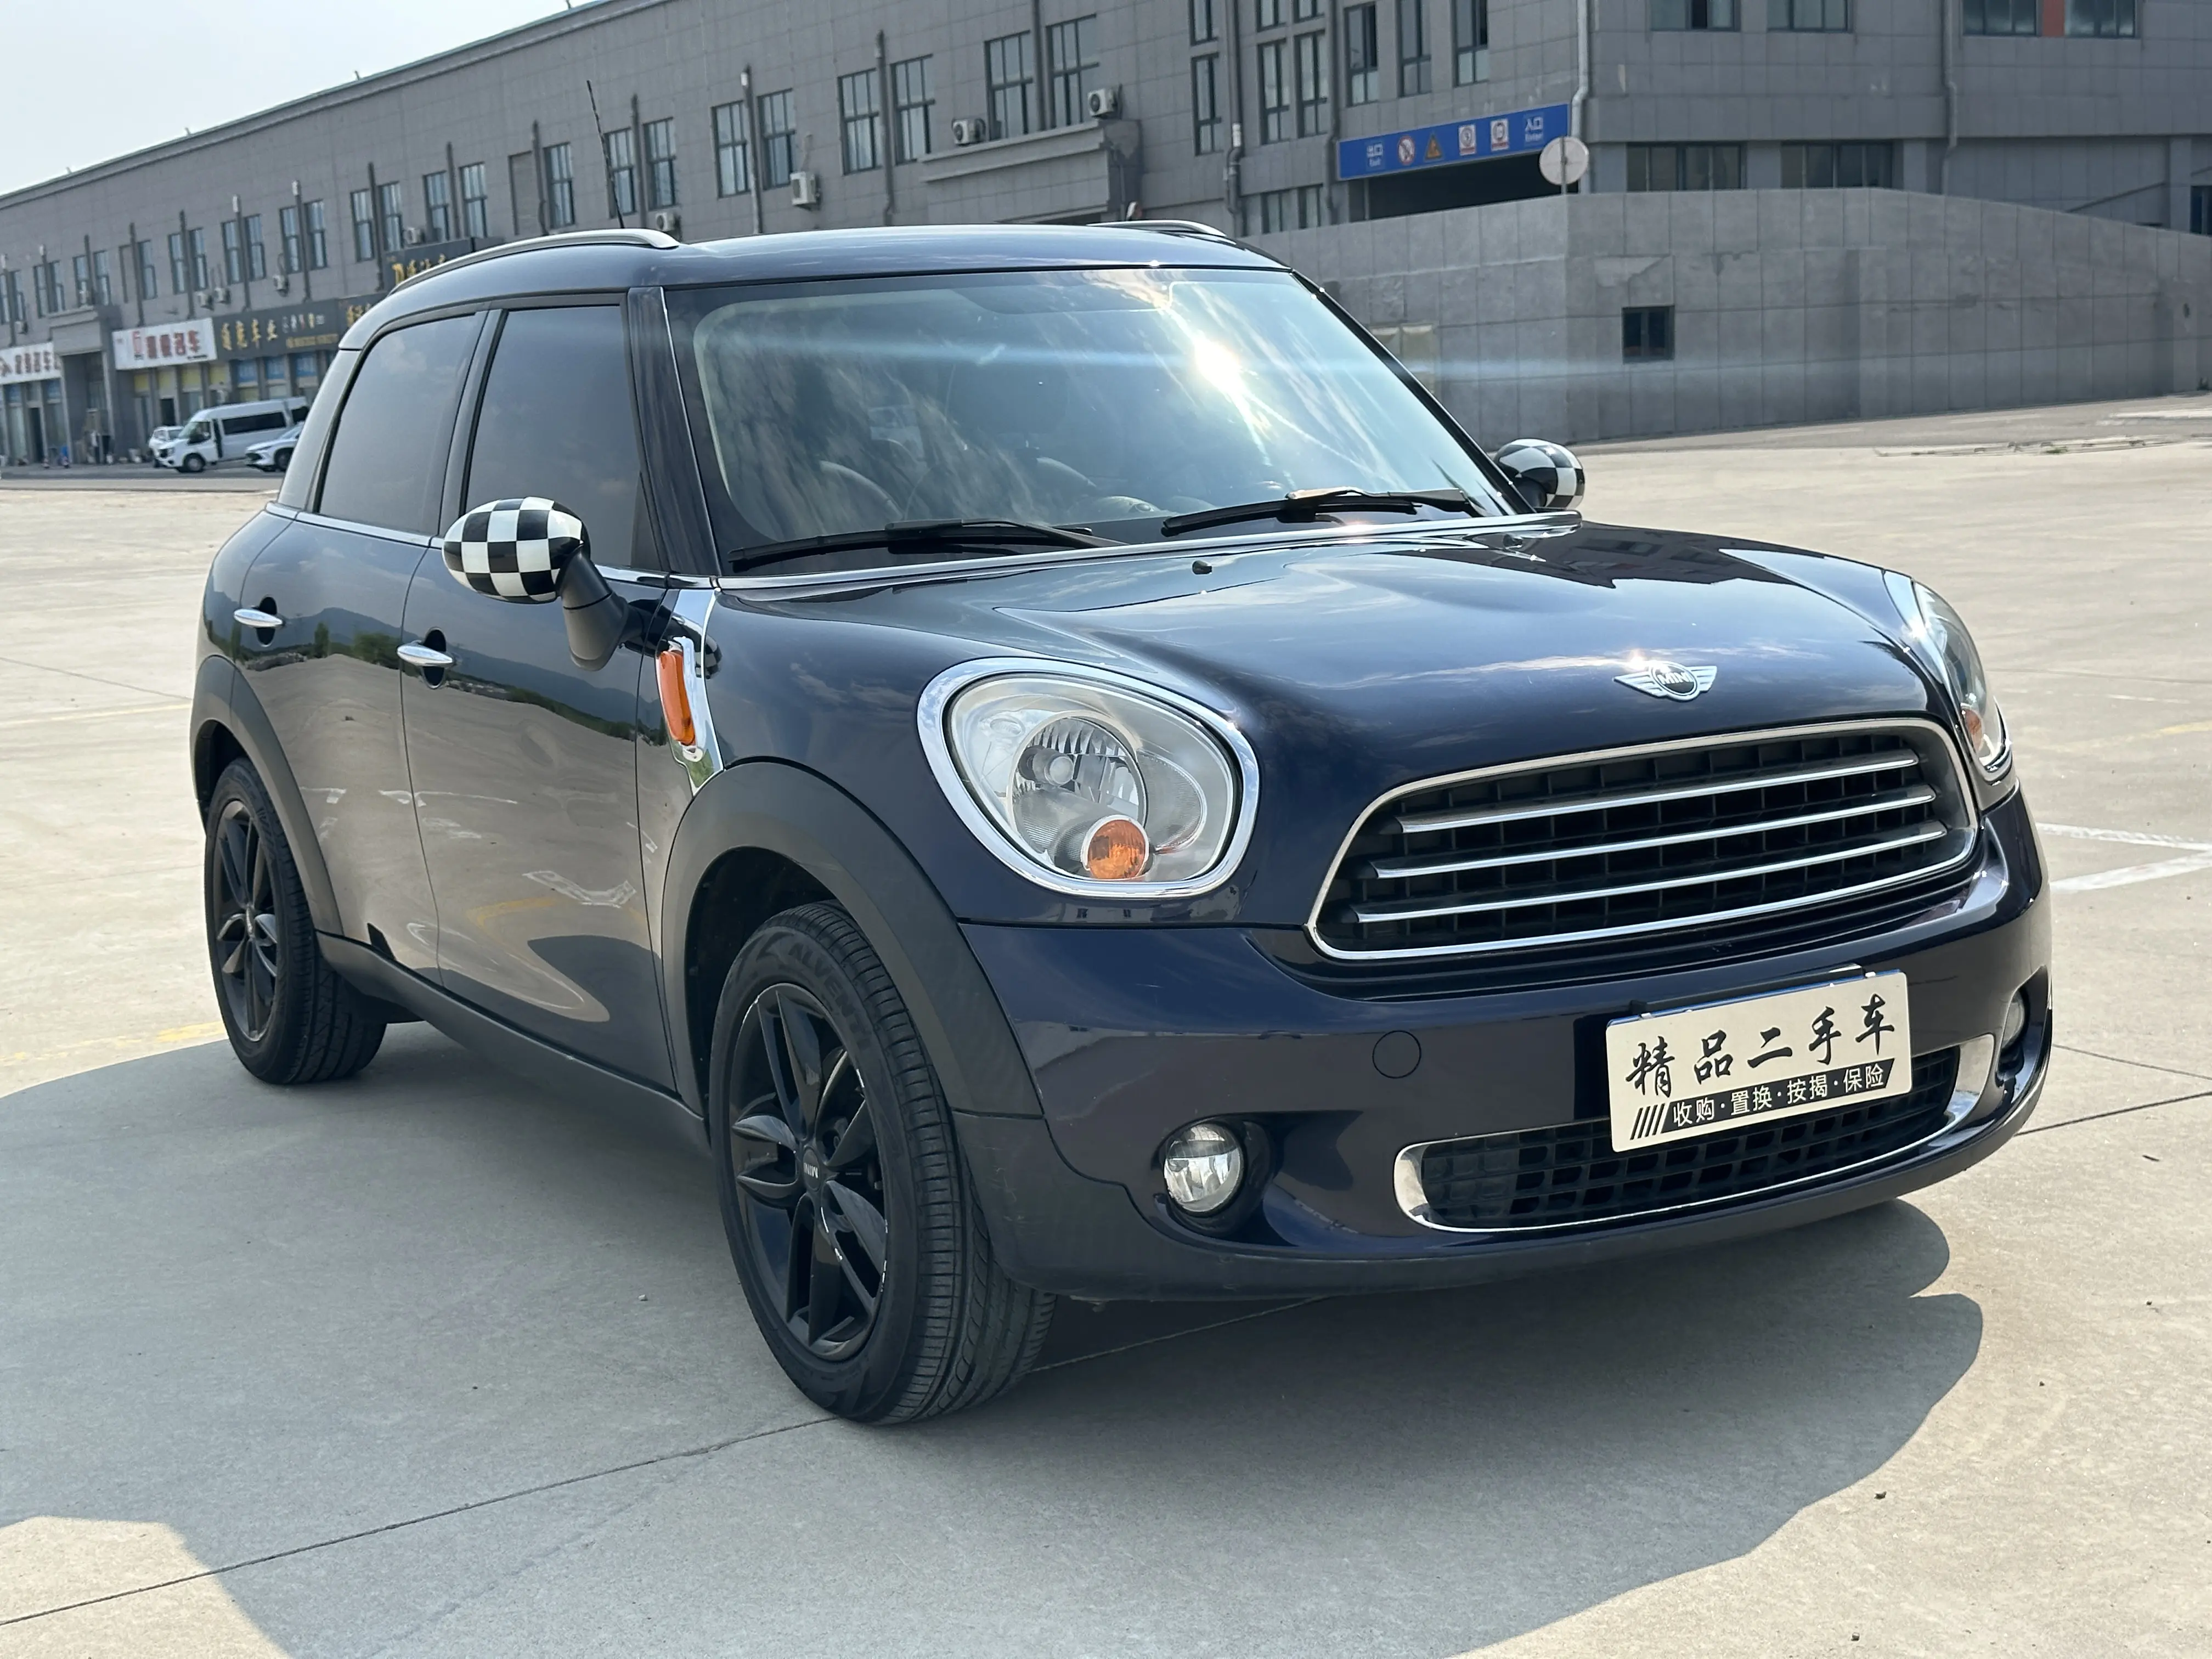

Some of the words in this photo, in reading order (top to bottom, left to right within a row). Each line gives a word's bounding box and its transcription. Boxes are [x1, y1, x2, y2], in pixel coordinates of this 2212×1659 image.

[1525, 116, 1544, 131] 入口
[1367, 143, 1383, 158] 出口
[1657, 672, 1694, 685] MINI
[1626, 994, 1895, 1098] 精品二手车
